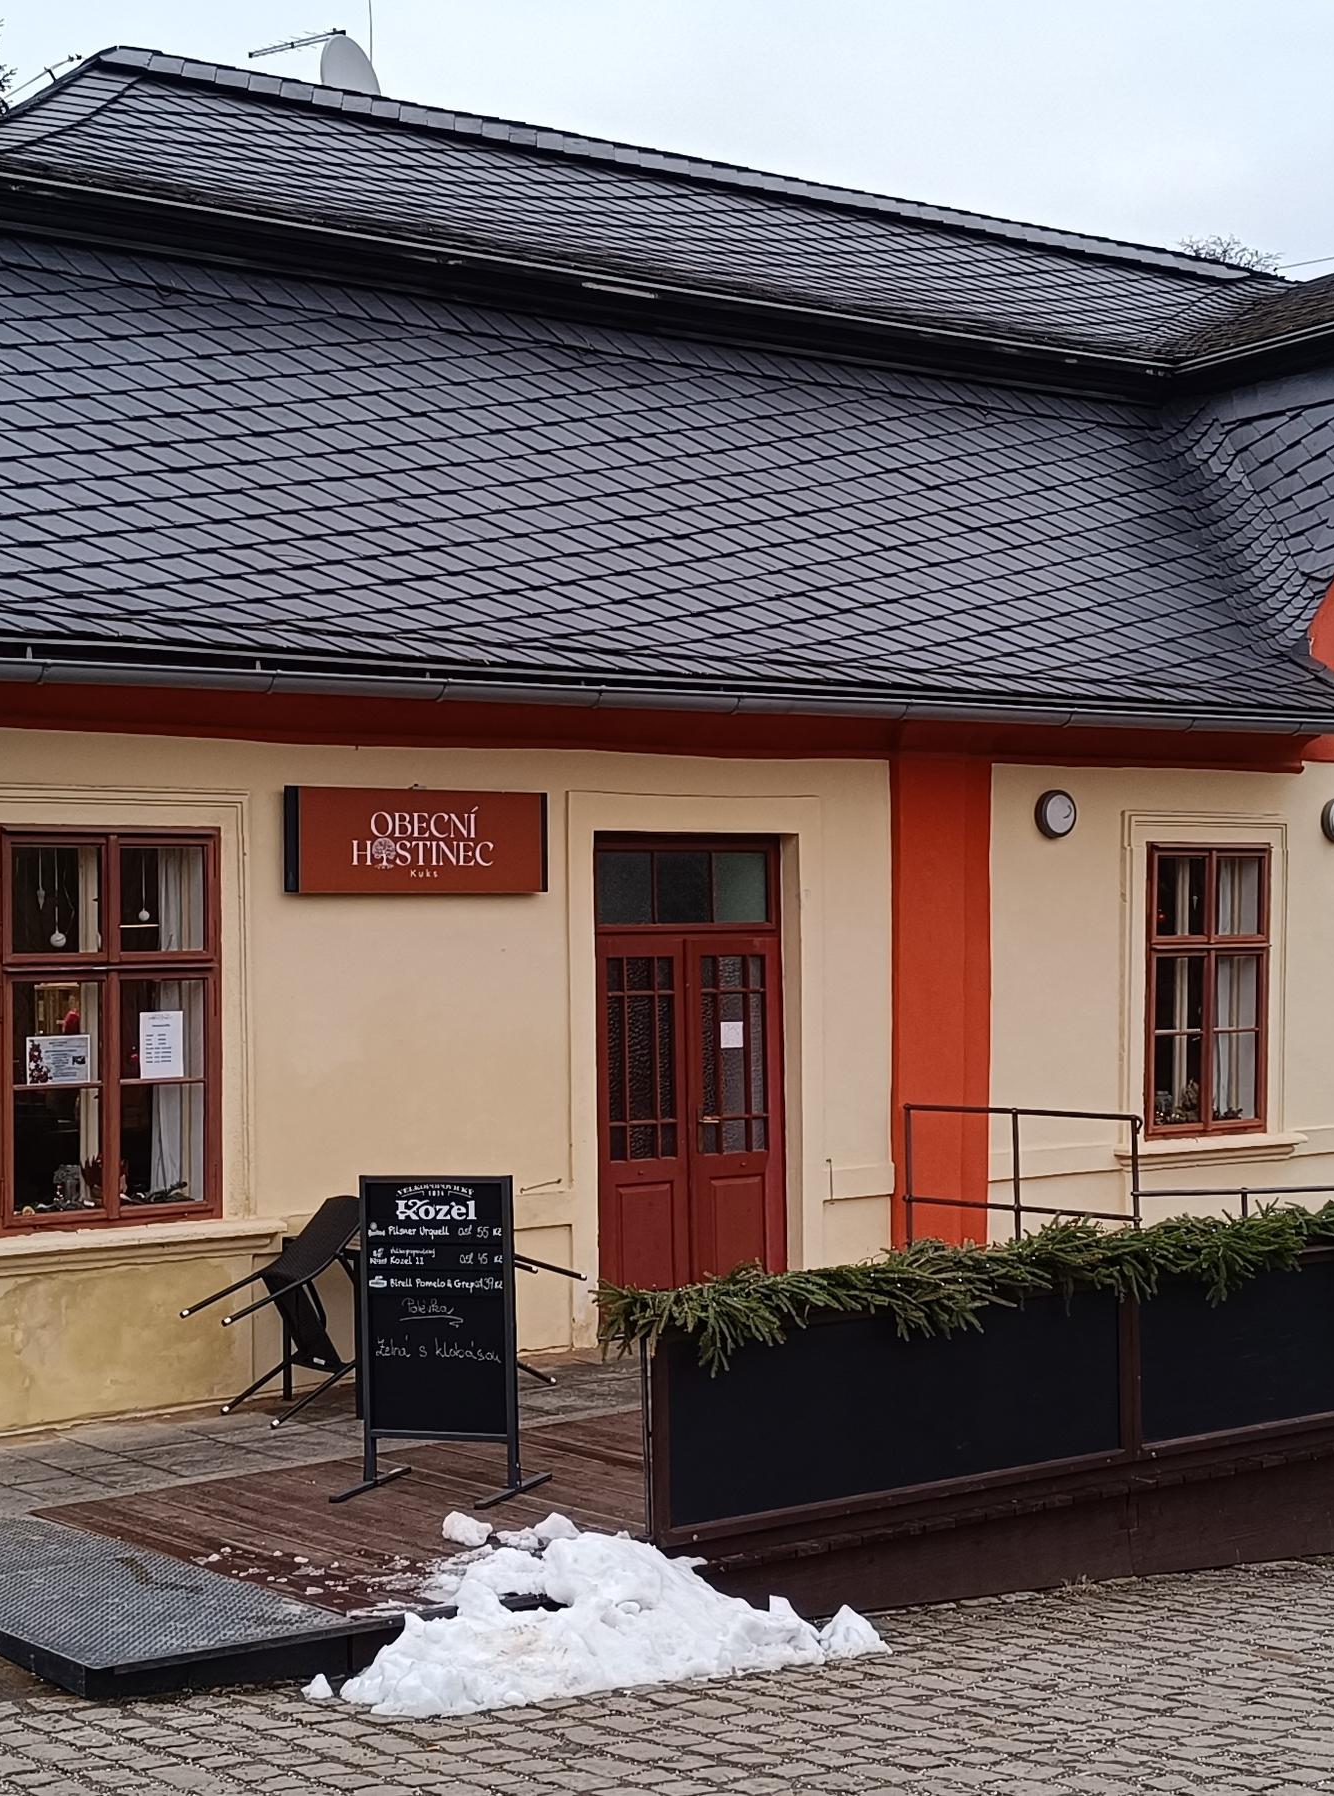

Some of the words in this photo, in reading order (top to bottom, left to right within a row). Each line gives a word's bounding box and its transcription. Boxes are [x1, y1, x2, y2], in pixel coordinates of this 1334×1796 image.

[370, 806, 479, 838] OBECNÍ
[410, 869, 438, 878] Kuks
[395, 1199, 477, 1220] Kozel
[388, 1225, 417, 1236] Pilsner
[419, 1226, 449, 1240] Urquell
[476, 1226, 489, 1238] 55
[390, 1256, 413, 1265] Kozel
[478, 1252, 488, 1264] 45
[390, 1278, 413, 1288] Birell
[415, 1278, 446, 1288] Pomelo
[419, 1345, 427, 1358] s
